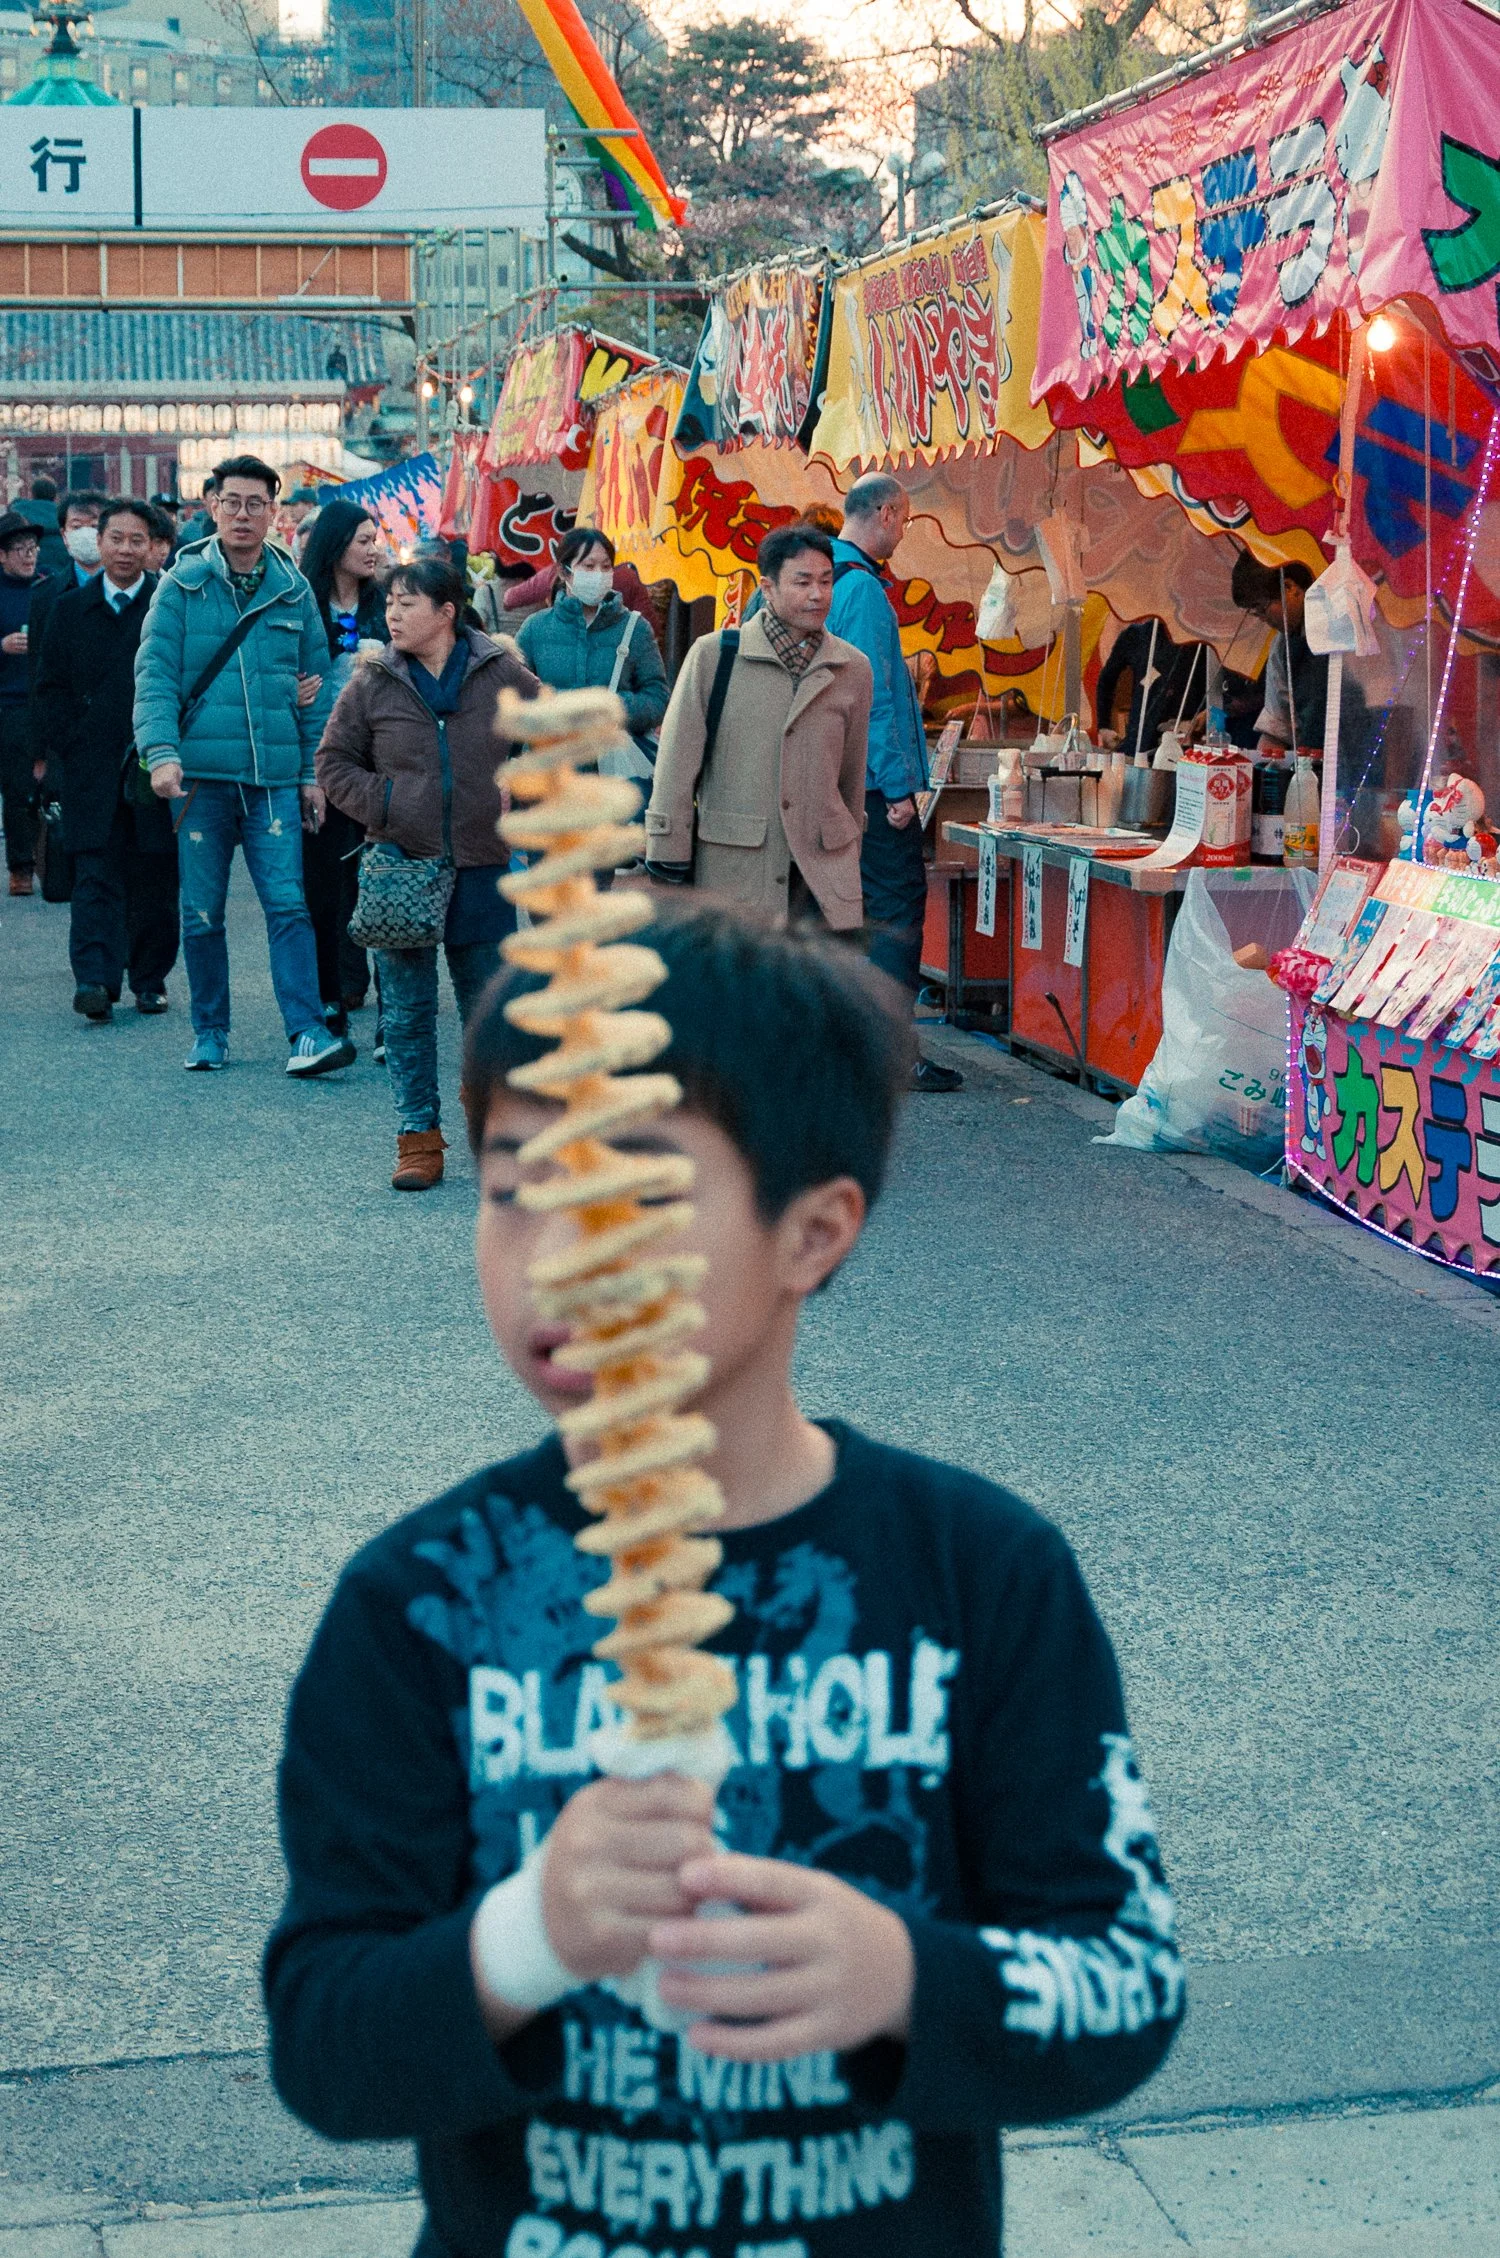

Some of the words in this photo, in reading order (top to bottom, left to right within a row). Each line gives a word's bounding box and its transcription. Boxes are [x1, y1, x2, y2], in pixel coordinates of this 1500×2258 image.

[30, 136, 87, 193] 行
[1094, 116, 1337, 352] カステラ
[526, 2116, 915, 2230] EVERYTHING
